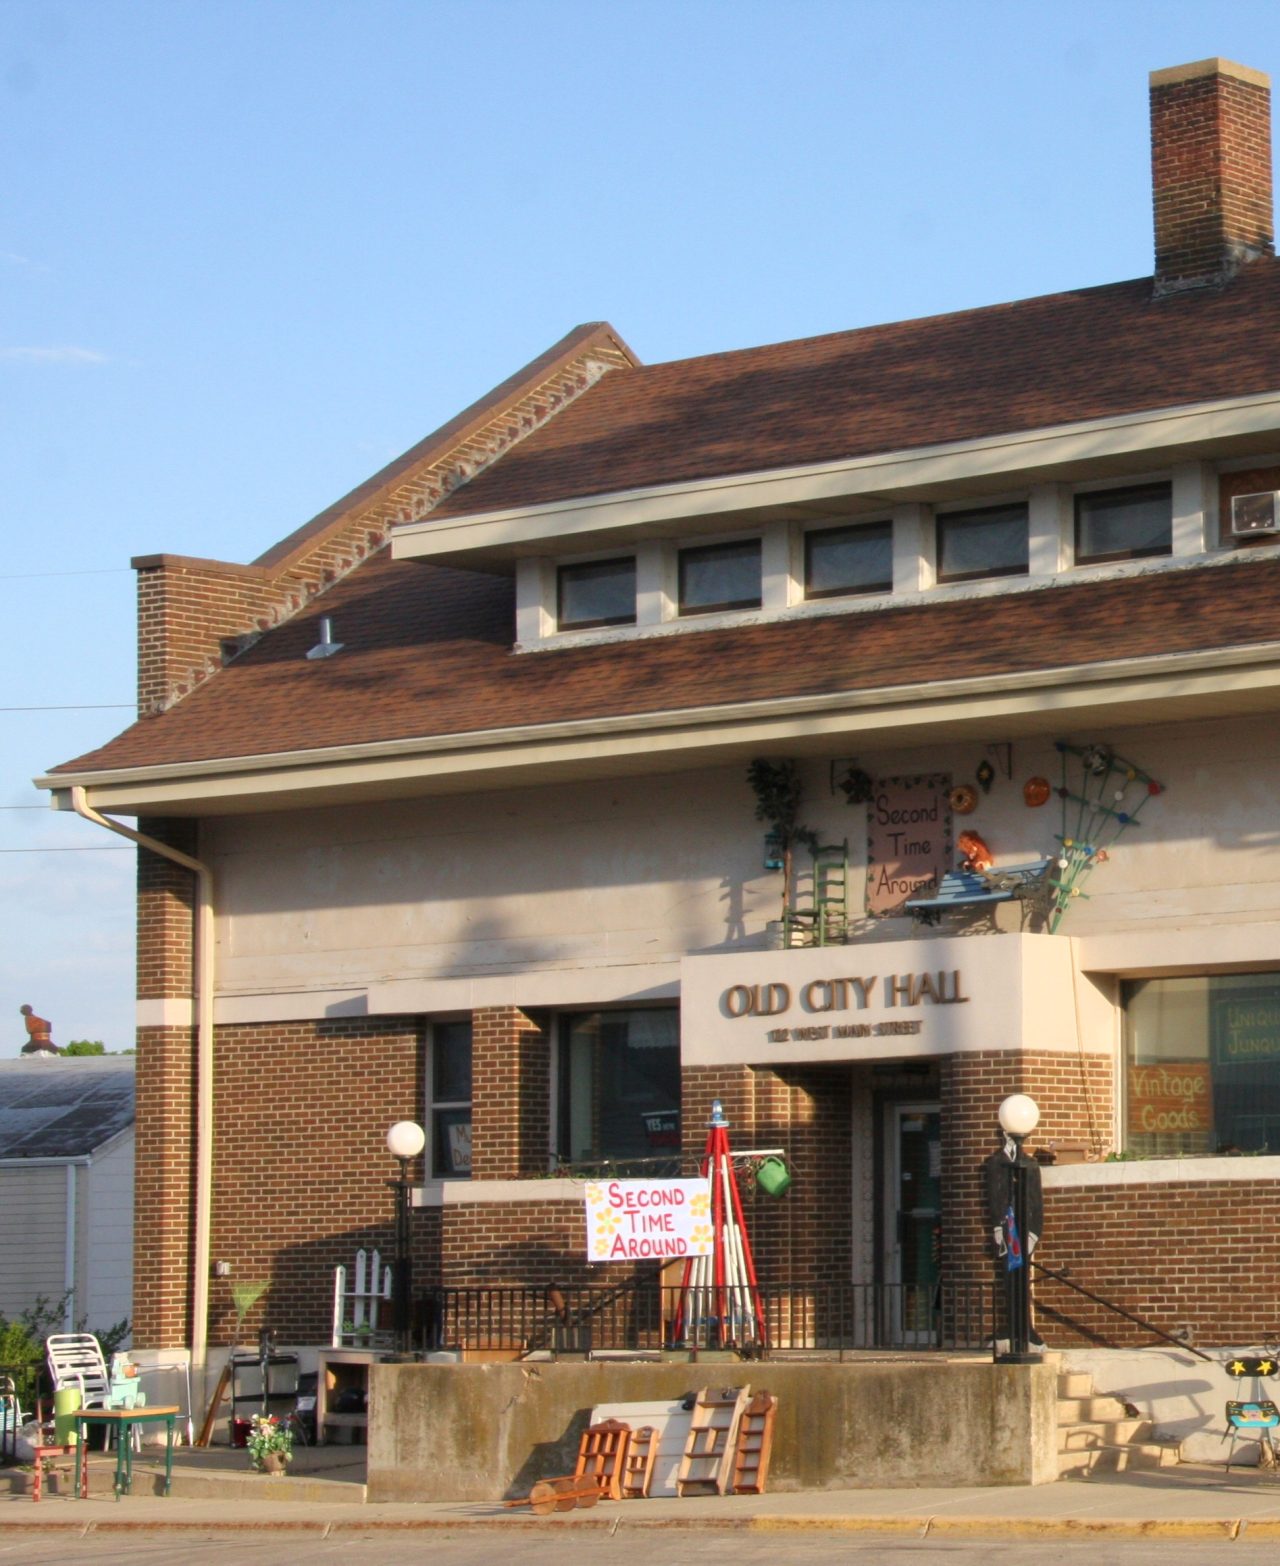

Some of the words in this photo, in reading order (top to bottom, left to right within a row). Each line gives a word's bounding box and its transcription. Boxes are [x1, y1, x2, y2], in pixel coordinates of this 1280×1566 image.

[876, 794, 938, 826] Second
[886, 832, 932, 856] Time
[876, 864, 938, 896] Around
[724, 982, 793, 1018] OLD
[805, 975, 878, 1012] CITY
[891, 969, 970, 1006] HALL
[834, 1023, 872, 1039] MAIN
[876, 1020, 924, 1037] STREET
[1131, 1068, 1206, 1103] Vintage
[645, 1118, 661, 1132] YES
[1140, 1104, 1200, 1131] Goods
[608, 1183, 685, 1208] SECOND
[623, 1210, 675, 1233] TIME
[610, 1233, 687, 1258] AROUND
